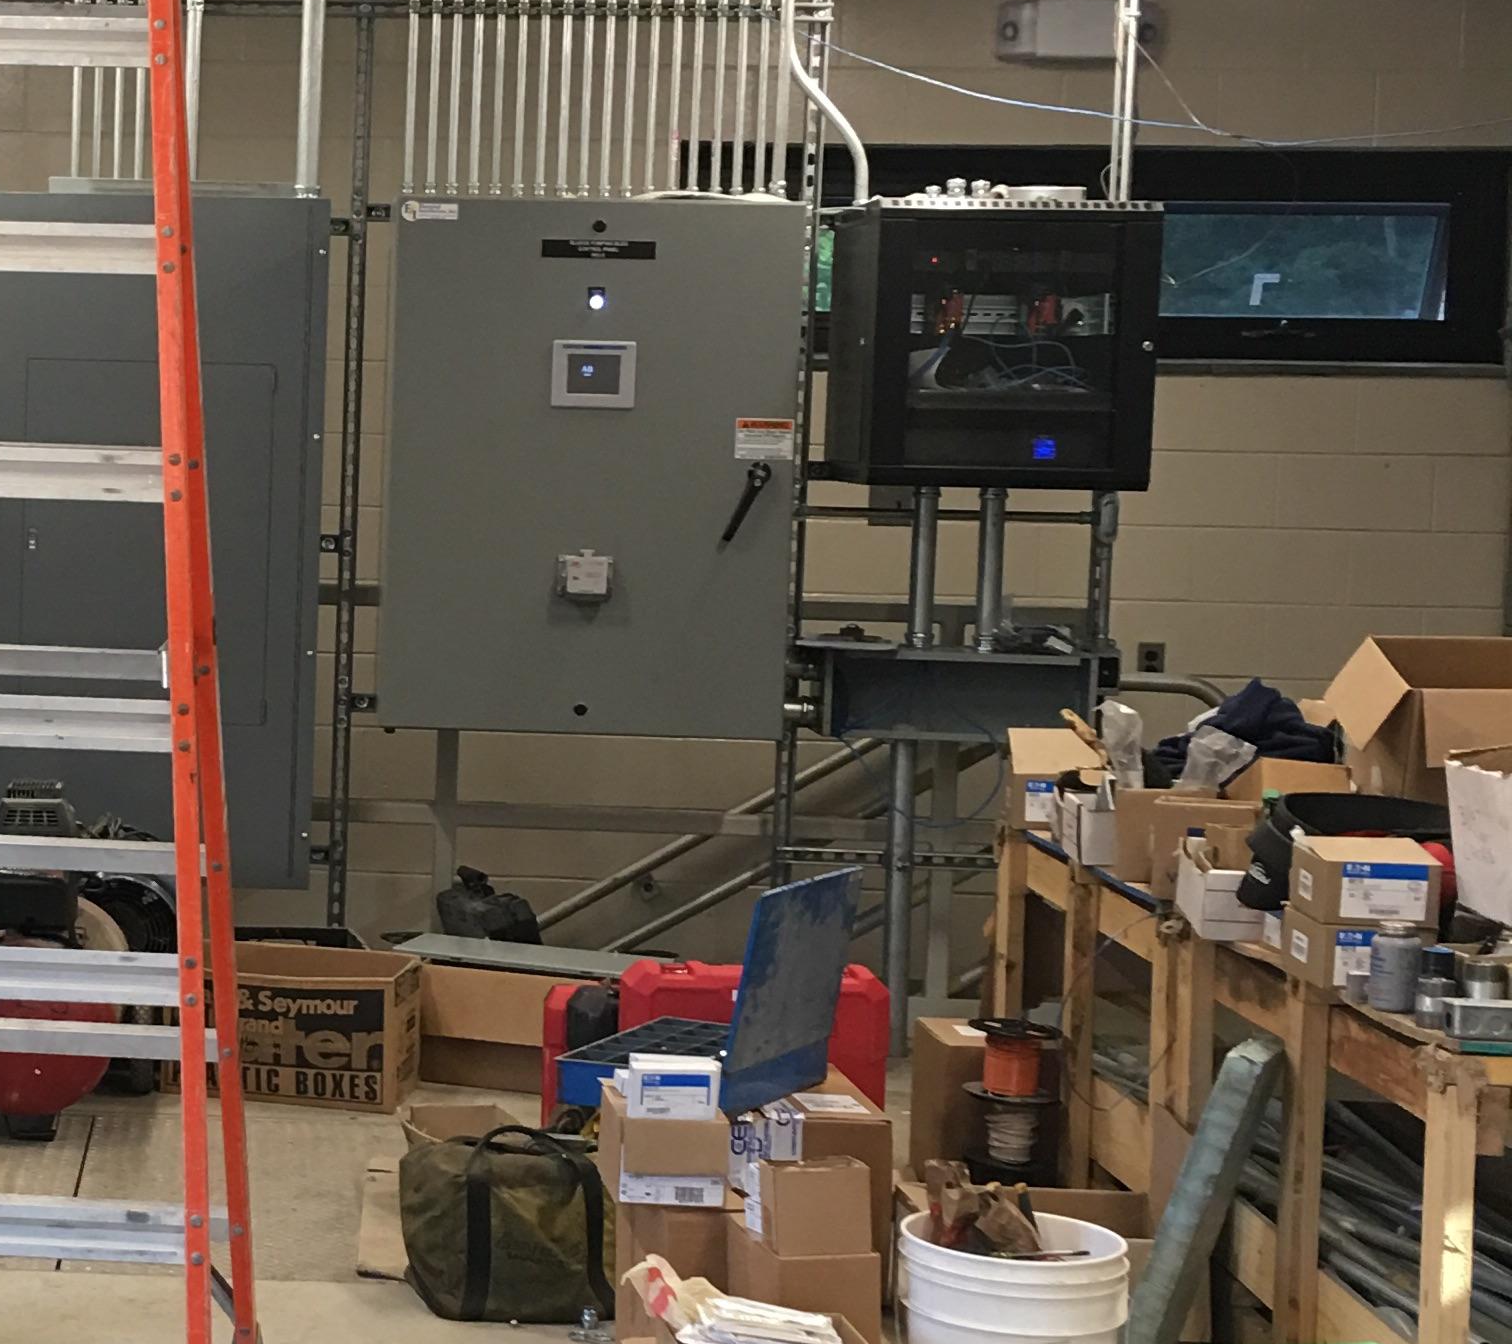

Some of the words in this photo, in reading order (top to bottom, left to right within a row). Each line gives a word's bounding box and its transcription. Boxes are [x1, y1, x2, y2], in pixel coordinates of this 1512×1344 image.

[238, 988, 254, 1011] &
[258, 990, 359, 1017] Seymour
[295, 1068, 378, 1102] BOXES
